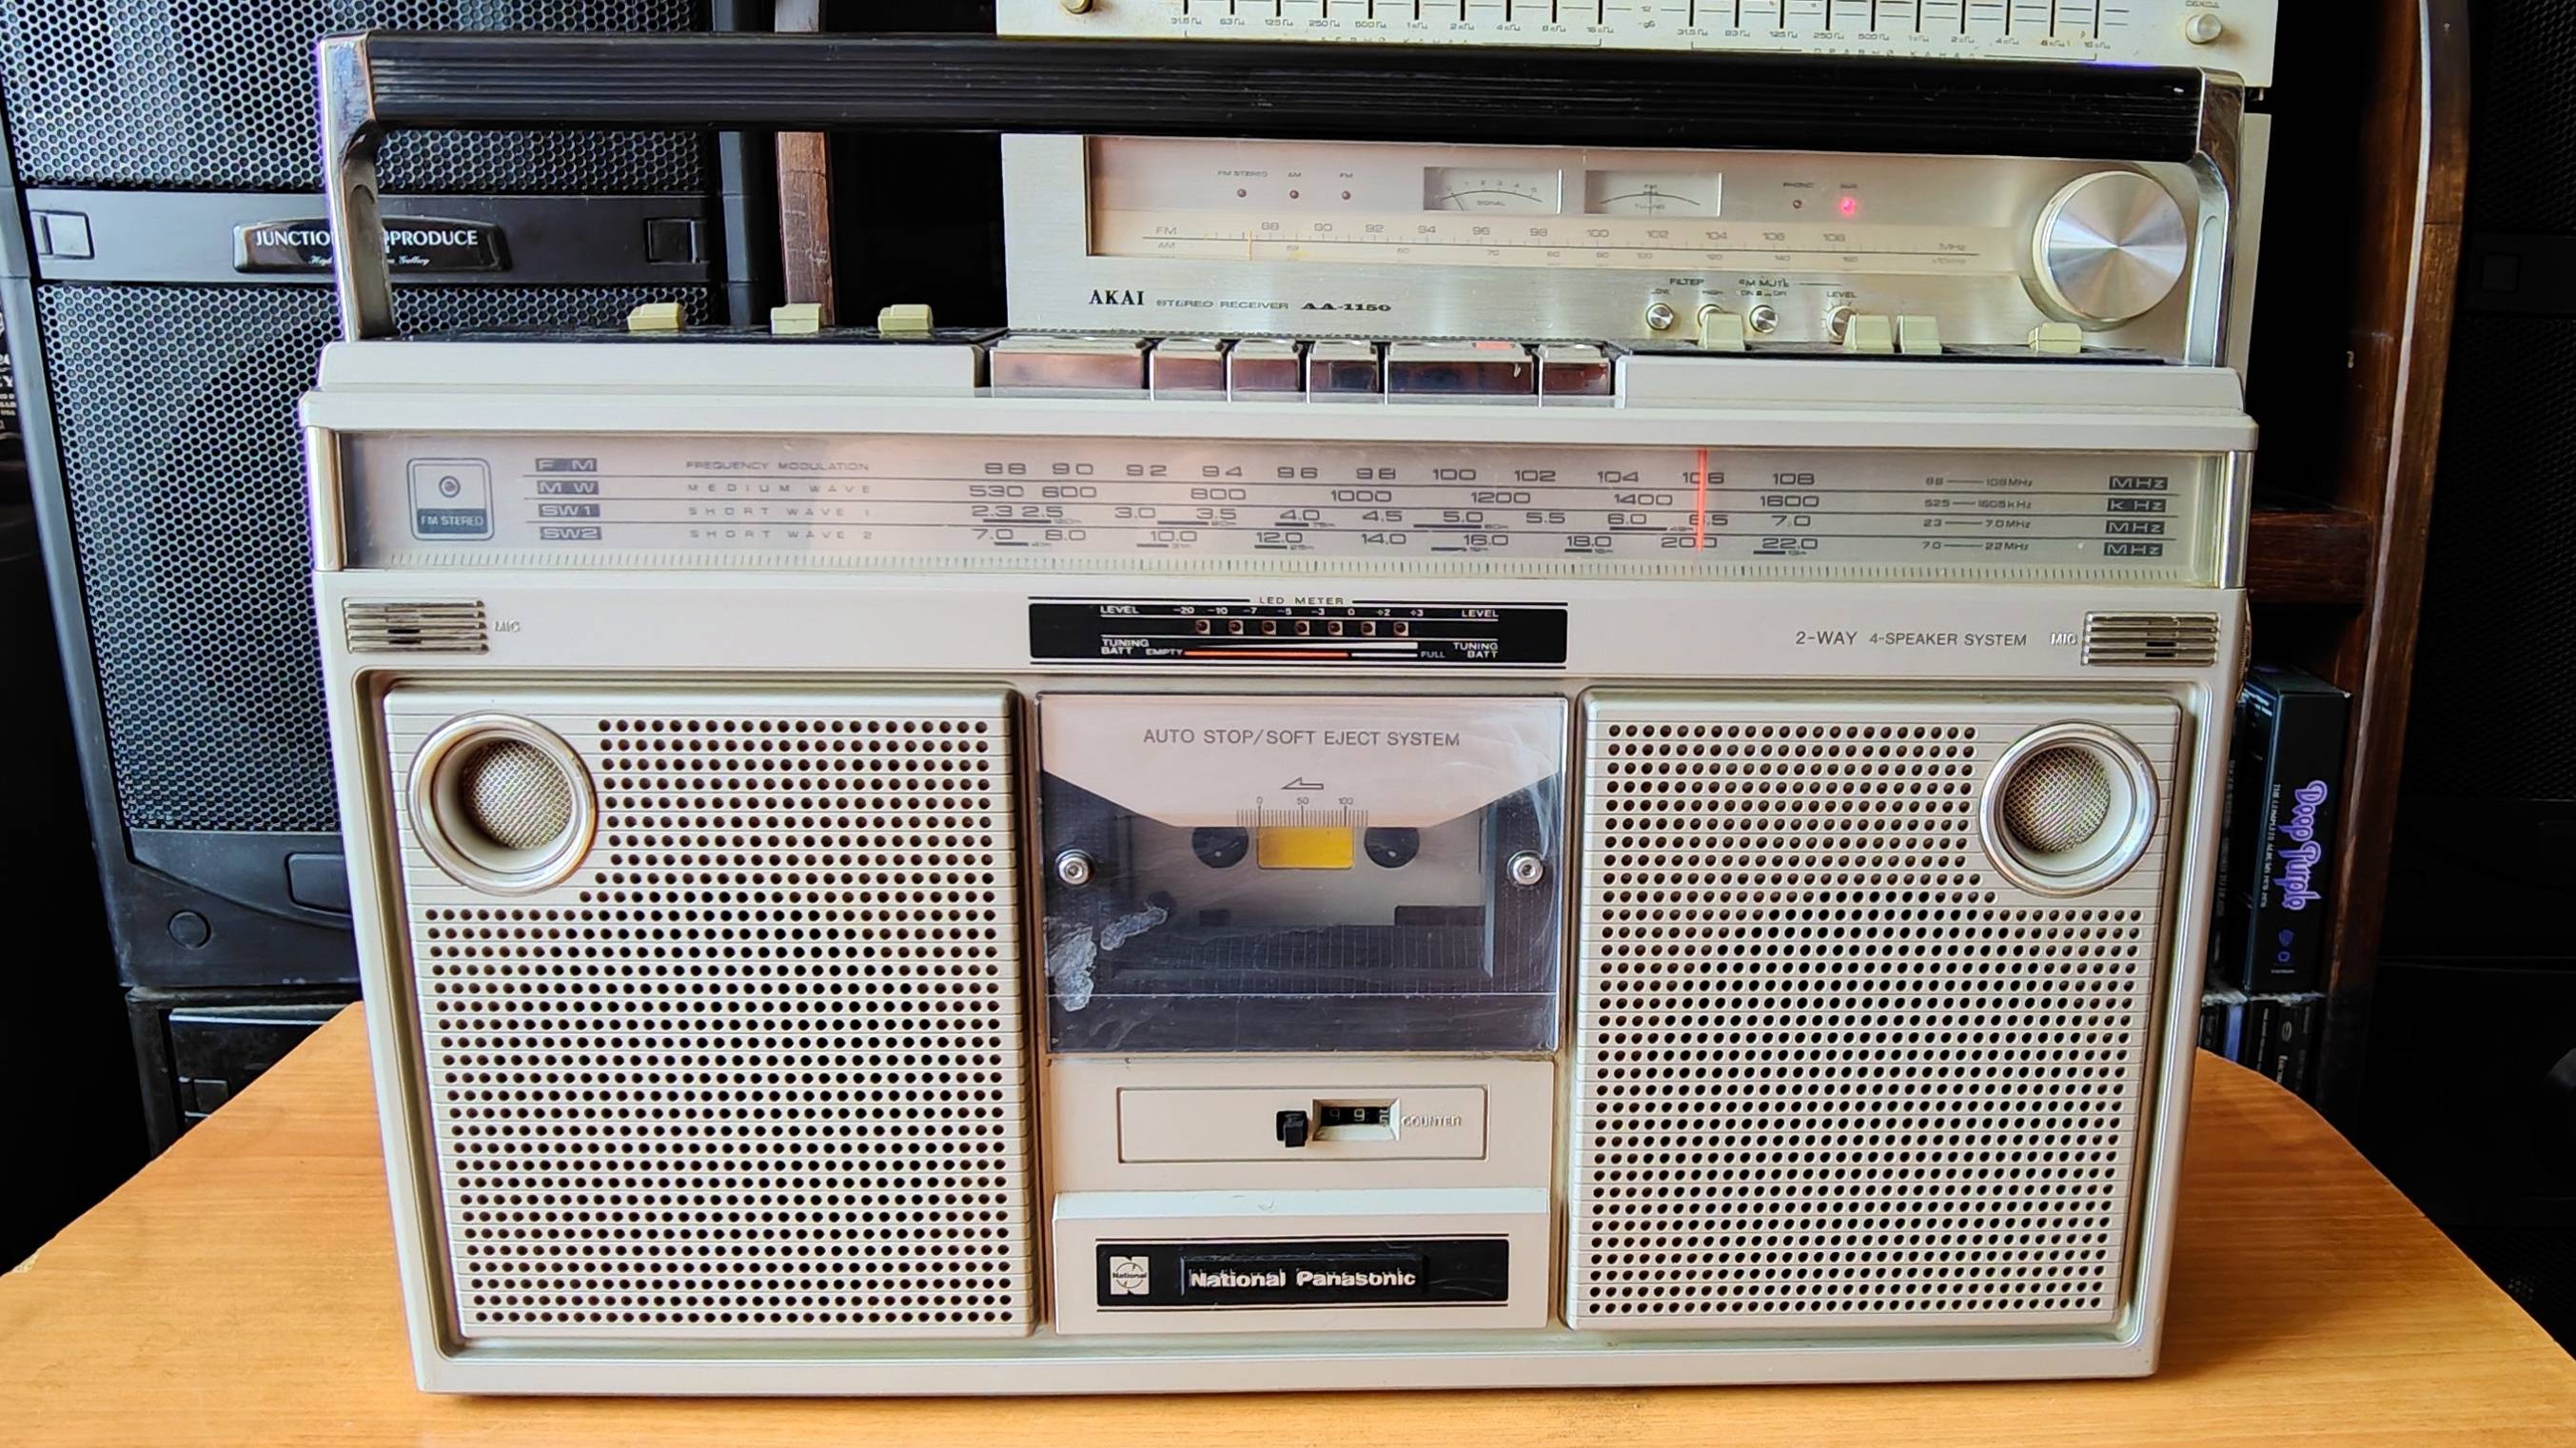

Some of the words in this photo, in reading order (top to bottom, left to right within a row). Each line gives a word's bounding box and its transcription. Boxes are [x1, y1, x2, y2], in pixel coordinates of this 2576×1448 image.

[256, 230, 334, 246] JUNCTIO
[390, 230, 478, 246] PRODUCE
[1156, 226, 1177, 235] FM
[1261, 222, 1279, 230] 88
[1365, 225, 1384, 233] 92
[1417, 225, 1436, 234] 94
[1472, 226, 1490, 236] 96
[1529, 227, 1547, 236] 98
[1586, 229, 1609, 238] 100
[1646, 230, 1669, 239] 102
[1705, 231, 1727, 240] 104
[1762, 232, 1785, 241] 106
[1089, 289, 1144, 306] AKAI
[1156, 299, 1214, 308] STEREO
[1221, 300, 1288, 309] RECEIVER
[1301, 303, 1391, 312] AA-1150
[686, 461, 769, 471] FREQUENCY
[778, 461, 869, 471] MODULATION
[985, 462, 1026, 475] 88
[1052, 463, 1093, 475] 90
[1126, 464, 1167, 477] 92
[1203, 465, 1242, 478] 94
[1277, 466, 1318, 479] 96
[1356, 467, 1396, 479] 98
[1432, 468, 1476, 481] 100
[1515, 470, 1556, 482] 102
[1598, 471, 1639, 483] 104
[1773, 473, 1815, 485] 108
[1926, 478, 1943, 486] 88
[2112, 478, 2166, 488] MHz
[688, 483, 790, 493] MEDIUM
[810, 484, 871, 494] WAVE
[969, 485, 1024, 498] 530
[1042, 486, 1096, 499] 600
[1190, 488, 1246, 500] 800
[1330, 489, 1392, 502] 1000
[1471, 491, 1530, 504] 1200
[1615, 493, 1673, 506] 1400
[1760, 495, 1819, 508] 1600
[1925, 499, 1950, 508] 525
[420, 515, 438, 526] FM
[441, 515, 484, 526] STEREO
[541, 505, 591, 517] SW1
[689, 507, 770, 516] SHORT
[787, 507, 844, 517] WAVE
[972, 505, 1013, 518] 2.3
[1021, 506, 1063, 518] 2.5
[1114, 506, 1155, 519] 3.0
[1196, 508, 1236, 519] 3.5
[1280, 509, 1320, 521] 4.0
[1363, 510, 1403, 522] 4.5
[1444, 511, 1483, 523] 5.0
[1526, 512, 1565, 524] 5.5
[1607, 513, 1646, 525] 6.0
[1771, 515, 1811, 527] 7.0
[2109, 521, 2162, 533] MHz
[543, 528, 598, 539] SW2
[689, 530, 771, 539] SHORT
[788, 530, 845, 539] WAVE
[863, 531, 873, 539] 2
[972, 528, 1013, 540] 7.0
[1045, 529, 1086, 541] 8.0
[1150, 530, 1197, 542] 10.0
[1256, 532, 1303, 544] 12.0
[1362, 533, 1406, 545] 14.0
[1464, 534, 1508, 546] 16.0
[1567, 536, 1612, 547] 18.0
[1762, 538, 1818, 550] 22.0
[2107, 543, 2160, 555] MHz
[1259, 597, 1285, 605] LED
[1295, 597, 1345, 606] METER
[1100, 606, 1140, 615] LEVEL
[1347, 608, 1355, 616] 0
[1378, 608, 1391, 616] +2
[1410, 609, 1425, 617] +3
[1462, 609, 1500, 617] LEVEL
[495, 620, 521, 633] MIC
[1102, 638, 1150, 648] TUNING
[1453, 642, 1499, 651] TUNING
[1796, 631, 1858, 645] 2-WAY
[1869, 633, 1957, 646] 4-SPEAKER
[1963, 633, 2027, 647] SYSTEM
[2051, 633, 2078, 645] MIC
[1101, 647, 1134, 656] BATT
[1467, 650, 1499, 658] BATT
[1143, 729, 1195, 744] AUTO
[1204, 729, 1317, 745] STOP/SOFT
[1324, 731, 1381, 746] EJECT
[1387, 732, 1461, 747] SYSTEM
[1256, 796, 1263, 806] 0
[1297, 797, 1309, 806] 50
[1338, 797, 1354, 806] 100
[2278, 780, 2328, 842] Deep
[2273, 840, 2322, 910] Purple
[1401, 1114, 1463, 1127] COUNTER
[1190, 1268, 1286, 1287] National
[1296, 1266, 1417, 1286] Panasonic
